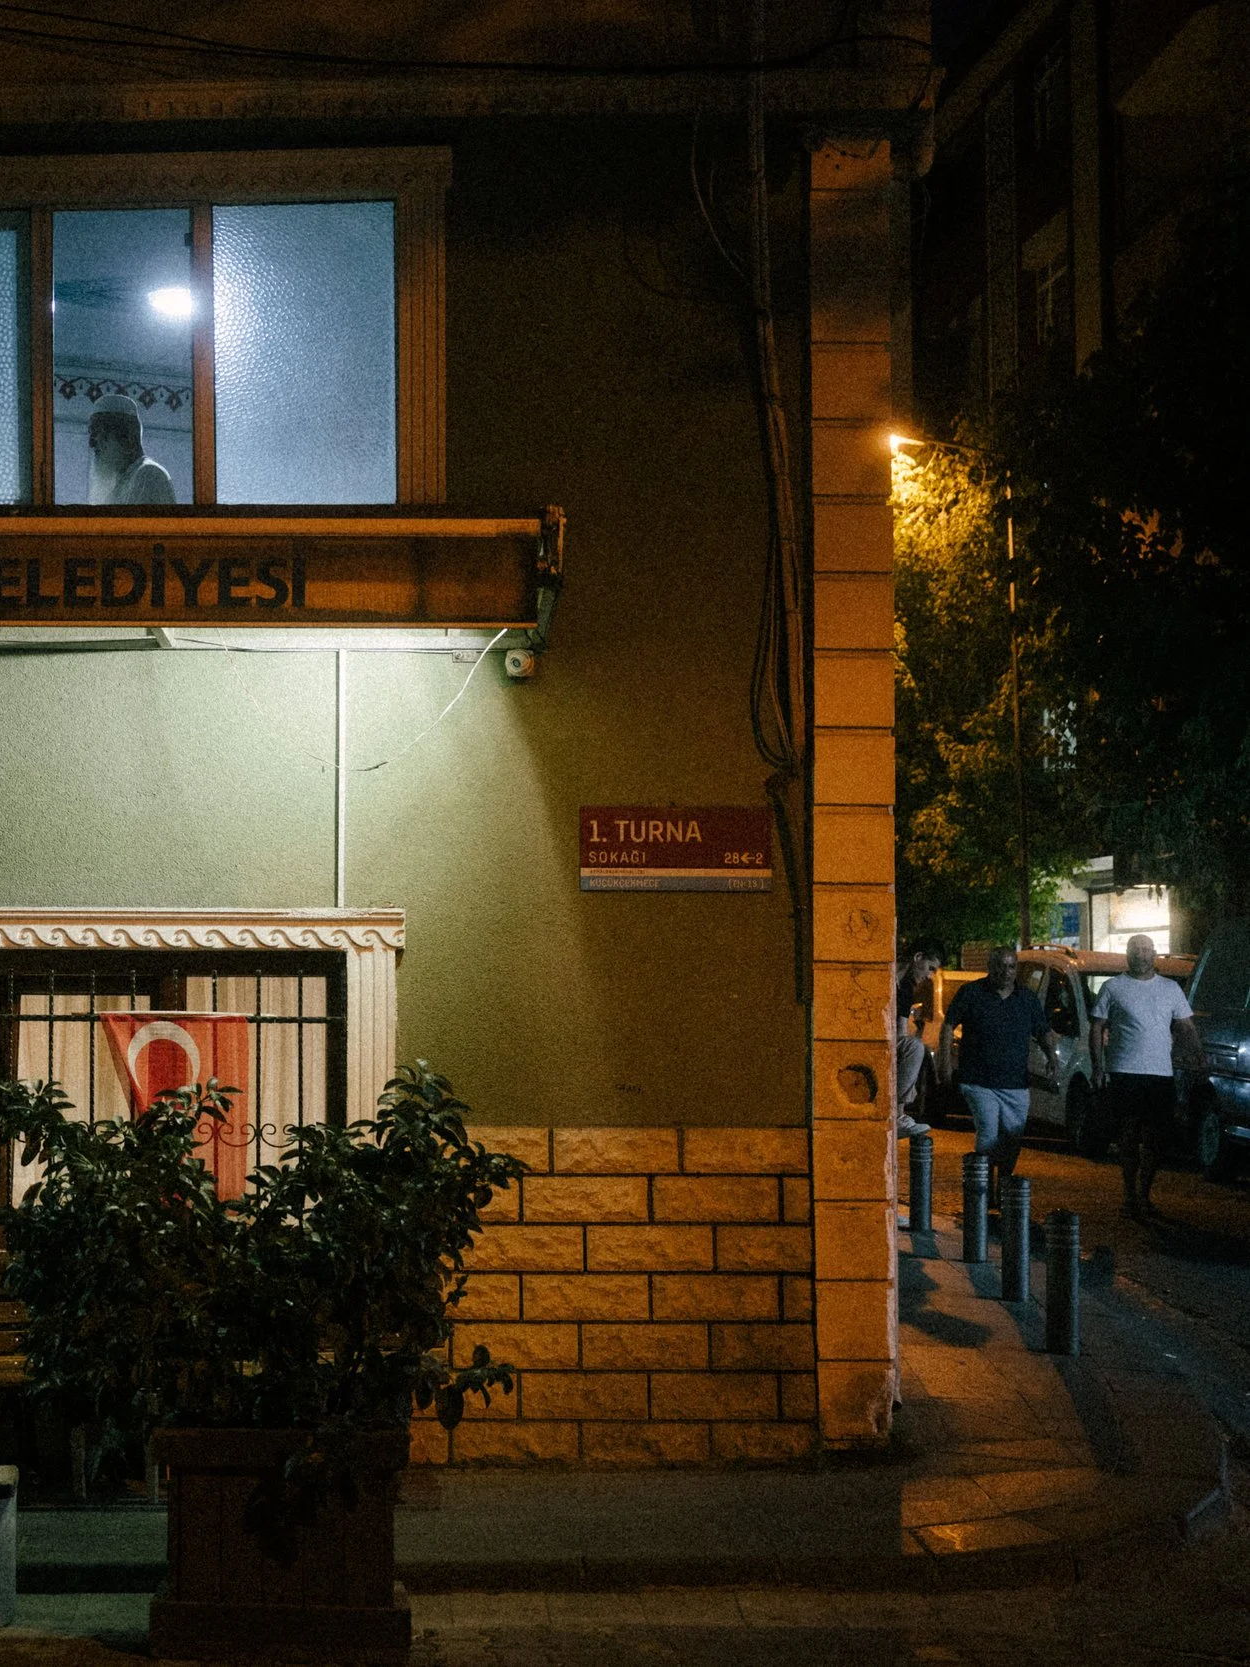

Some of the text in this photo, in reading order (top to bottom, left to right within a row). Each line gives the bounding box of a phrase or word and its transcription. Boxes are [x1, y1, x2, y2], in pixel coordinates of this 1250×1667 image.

[589, 820, 703, 843] 1. TURNA
[588, 850, 647, 865] SOKAĞI
